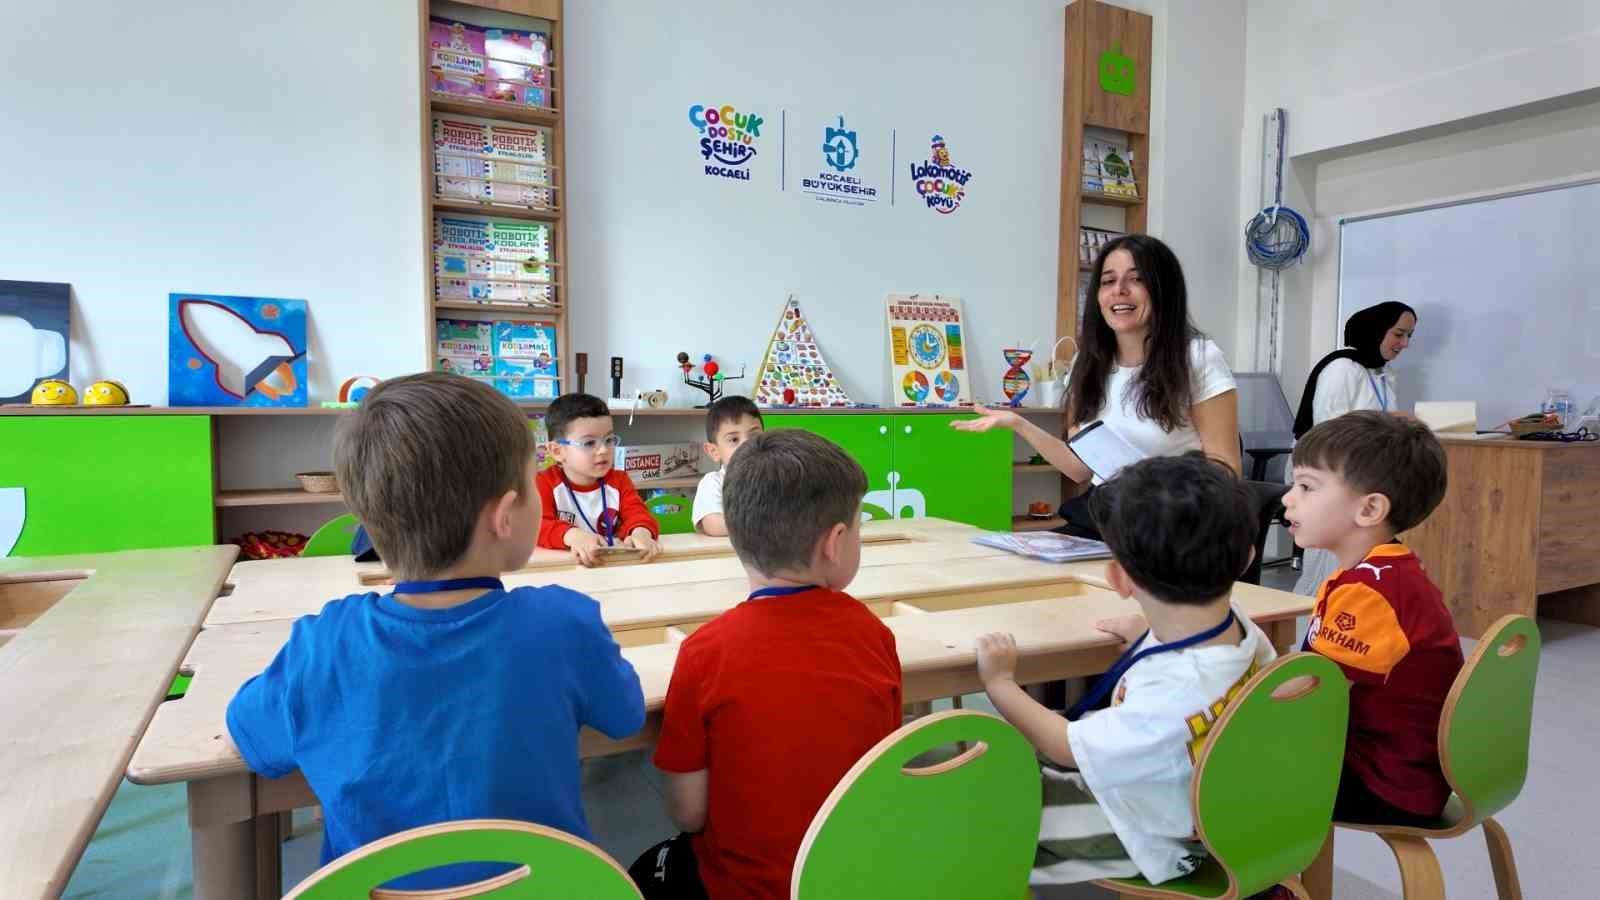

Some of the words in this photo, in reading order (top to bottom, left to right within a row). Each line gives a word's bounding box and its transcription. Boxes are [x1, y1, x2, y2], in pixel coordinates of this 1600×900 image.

[689, 104, 763, 137] ÇOCUK
[708, 126, 752, 145] DOSTU
[700, 137, 746, 160] ŞEHİR
[704, 164, 750, 181] KOCAELİ
[910, 160, 972, 186] Lokomotif
[916, 180, 961, 199] ÇOCUK
[625, 456, 660, 469] DISTANCE
